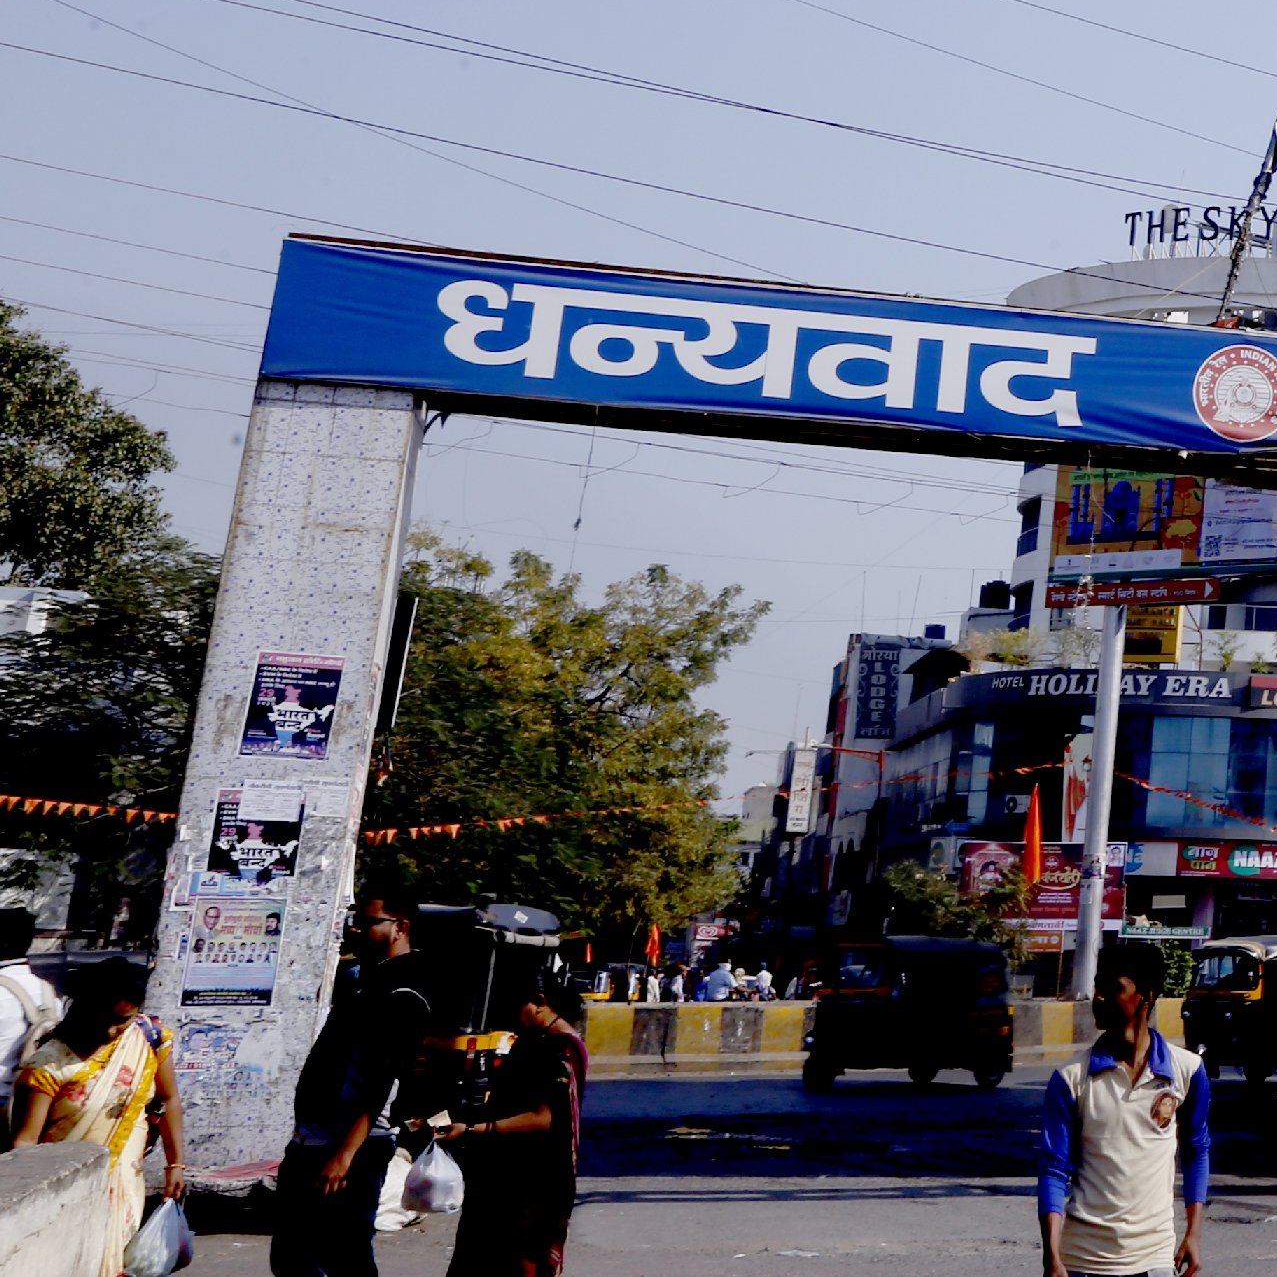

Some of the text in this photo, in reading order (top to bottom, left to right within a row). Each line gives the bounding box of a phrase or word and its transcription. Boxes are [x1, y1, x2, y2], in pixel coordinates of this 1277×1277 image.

[1124, 206, 1191, 246] THE
[436, 278, 1098, 428] धन्यवाद
[1240, 349, 1277, 372] INDIAN
[868, 661, 887, 722] LODGE
[991, 673, 1233, 699] HOTEL HOLIAY ERA
[220, 827, 237, 836] 29
